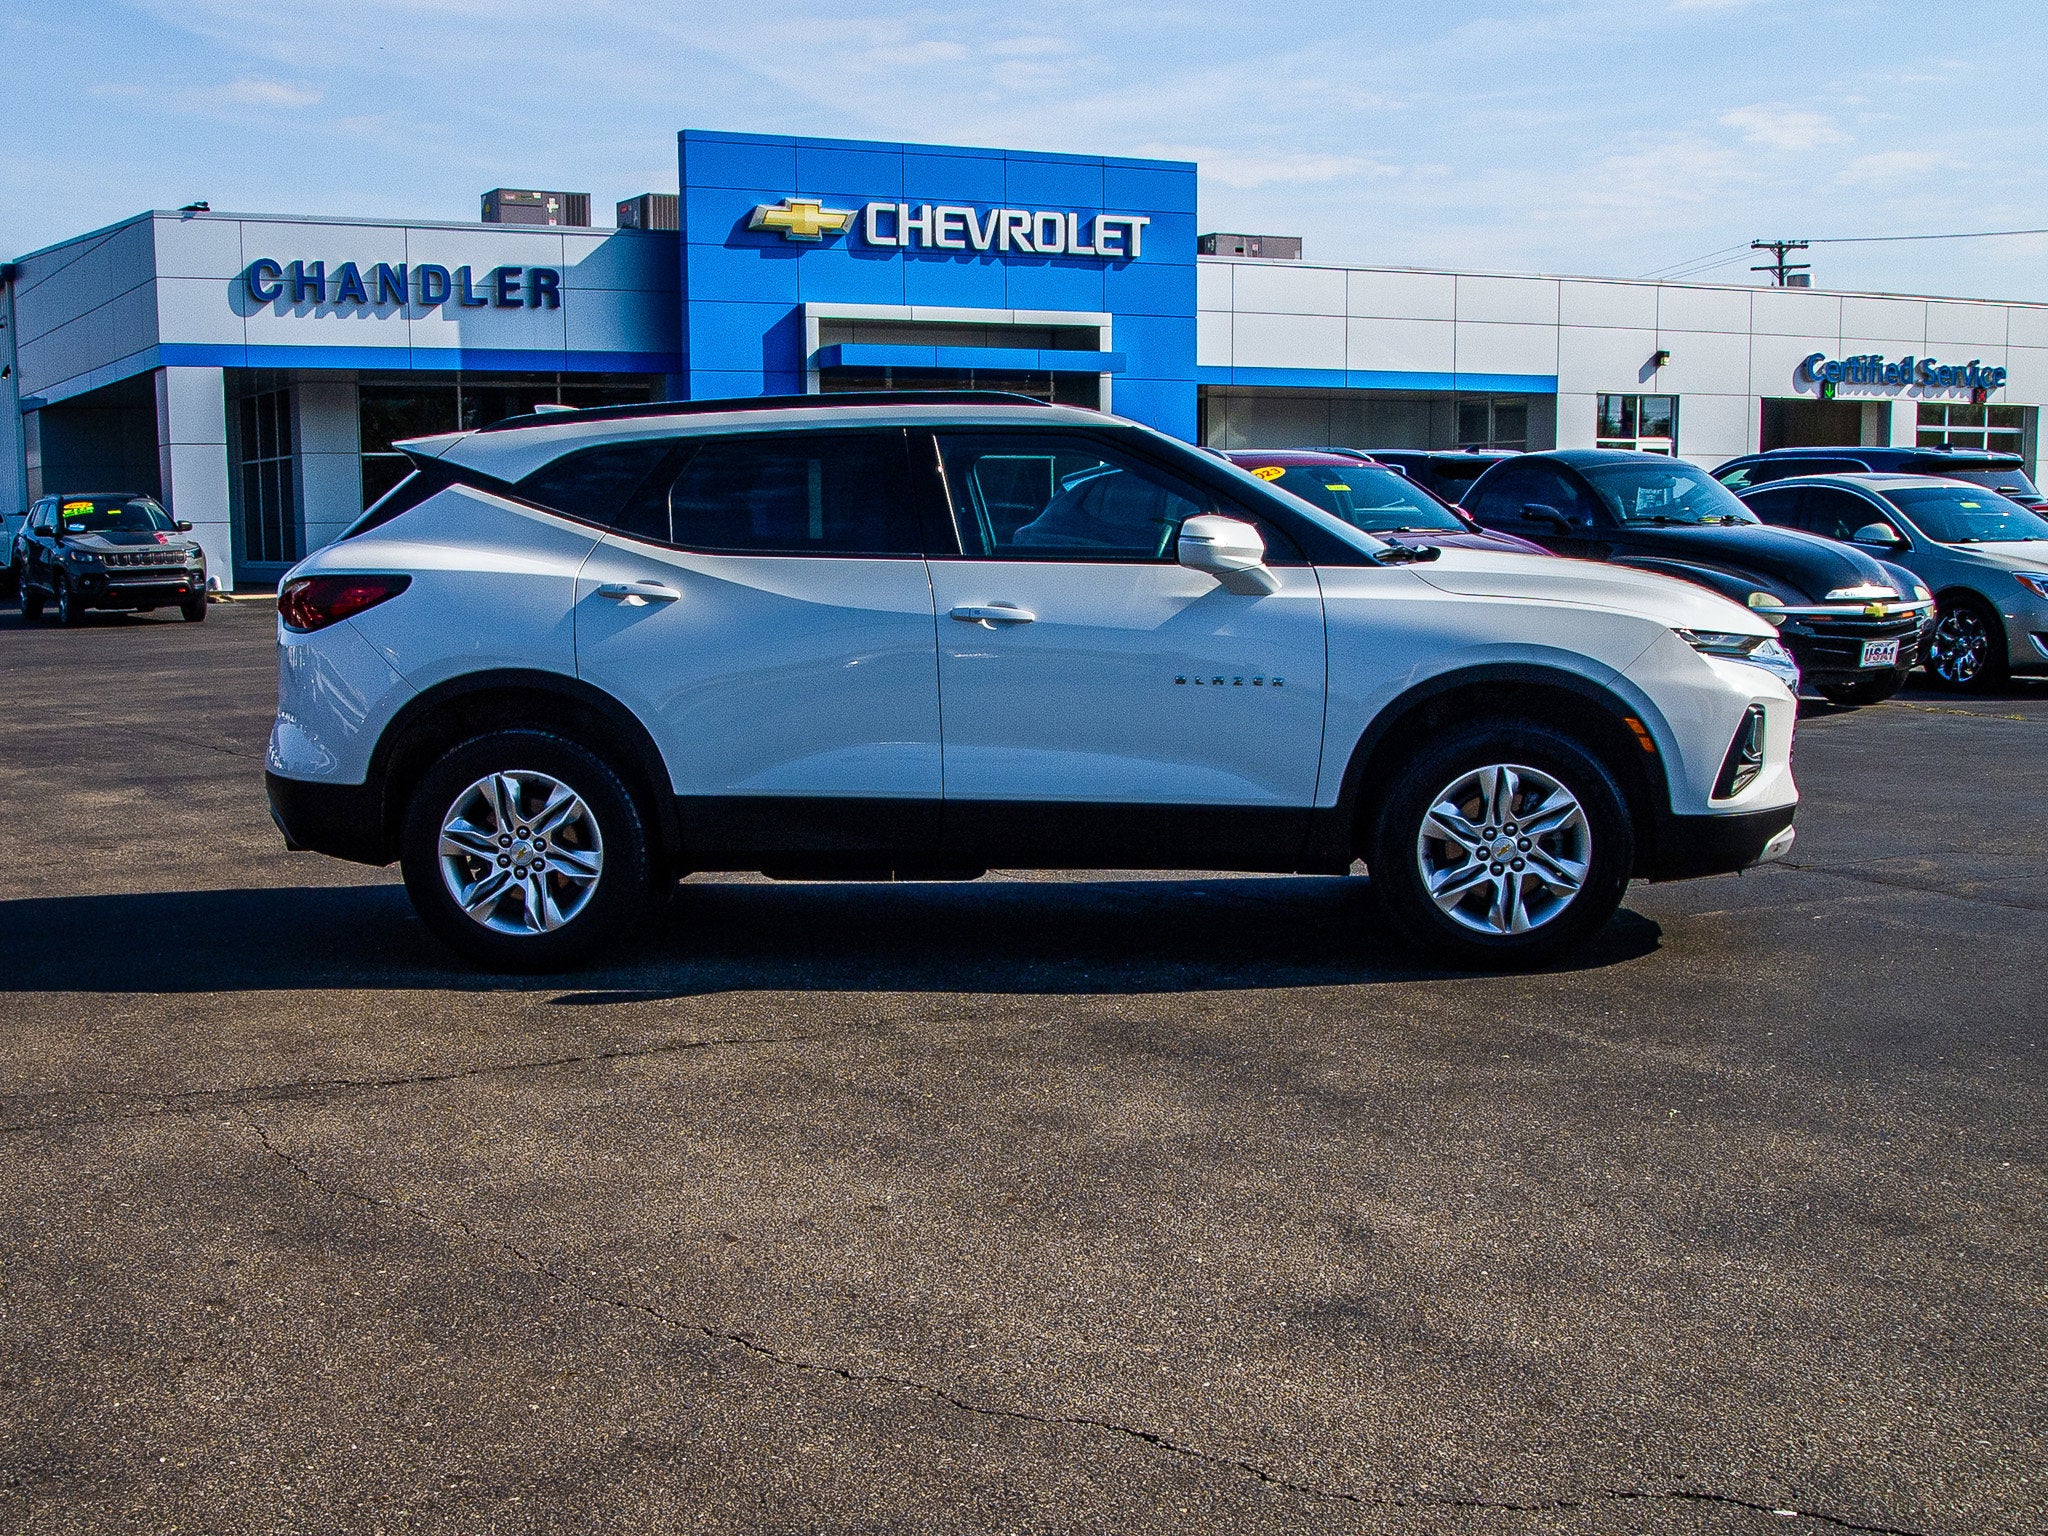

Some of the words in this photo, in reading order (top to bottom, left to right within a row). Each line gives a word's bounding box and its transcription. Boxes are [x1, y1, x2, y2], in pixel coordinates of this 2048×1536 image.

[866, 202, 1150, 257] CHEVROLET
[250, 257, 561, 309] CHANDLER
[1806, 352, 1914, 386] Certified
[1922, 358, 2007, 388] Service
[1254, 467, 1281, 480] 023
[1864, 647, 1896, 662] USA1
[1174, 675, 1284, 687] BLAZER
